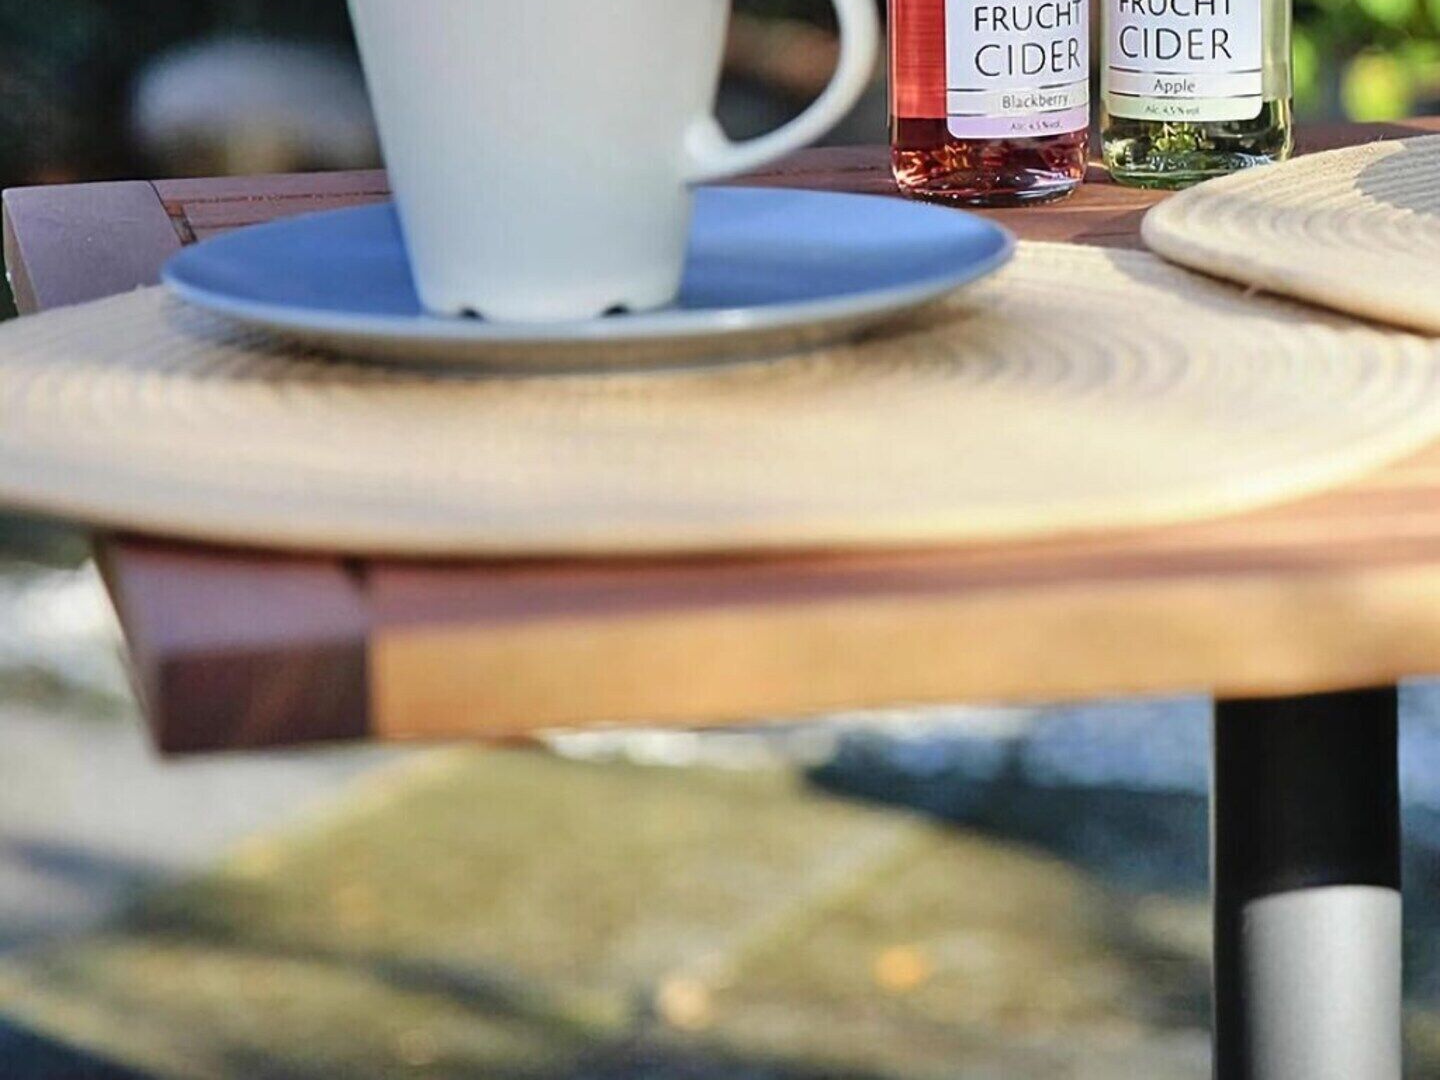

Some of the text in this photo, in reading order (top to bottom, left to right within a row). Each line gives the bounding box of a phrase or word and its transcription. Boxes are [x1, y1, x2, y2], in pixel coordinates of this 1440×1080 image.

[1119, 25, 1233, 61] CIDER
[974, 37, 1081, 77] CIDER
[1153, 78, 1197, 94] Apple
[1001, 94, 1069, 109] Blackberry
